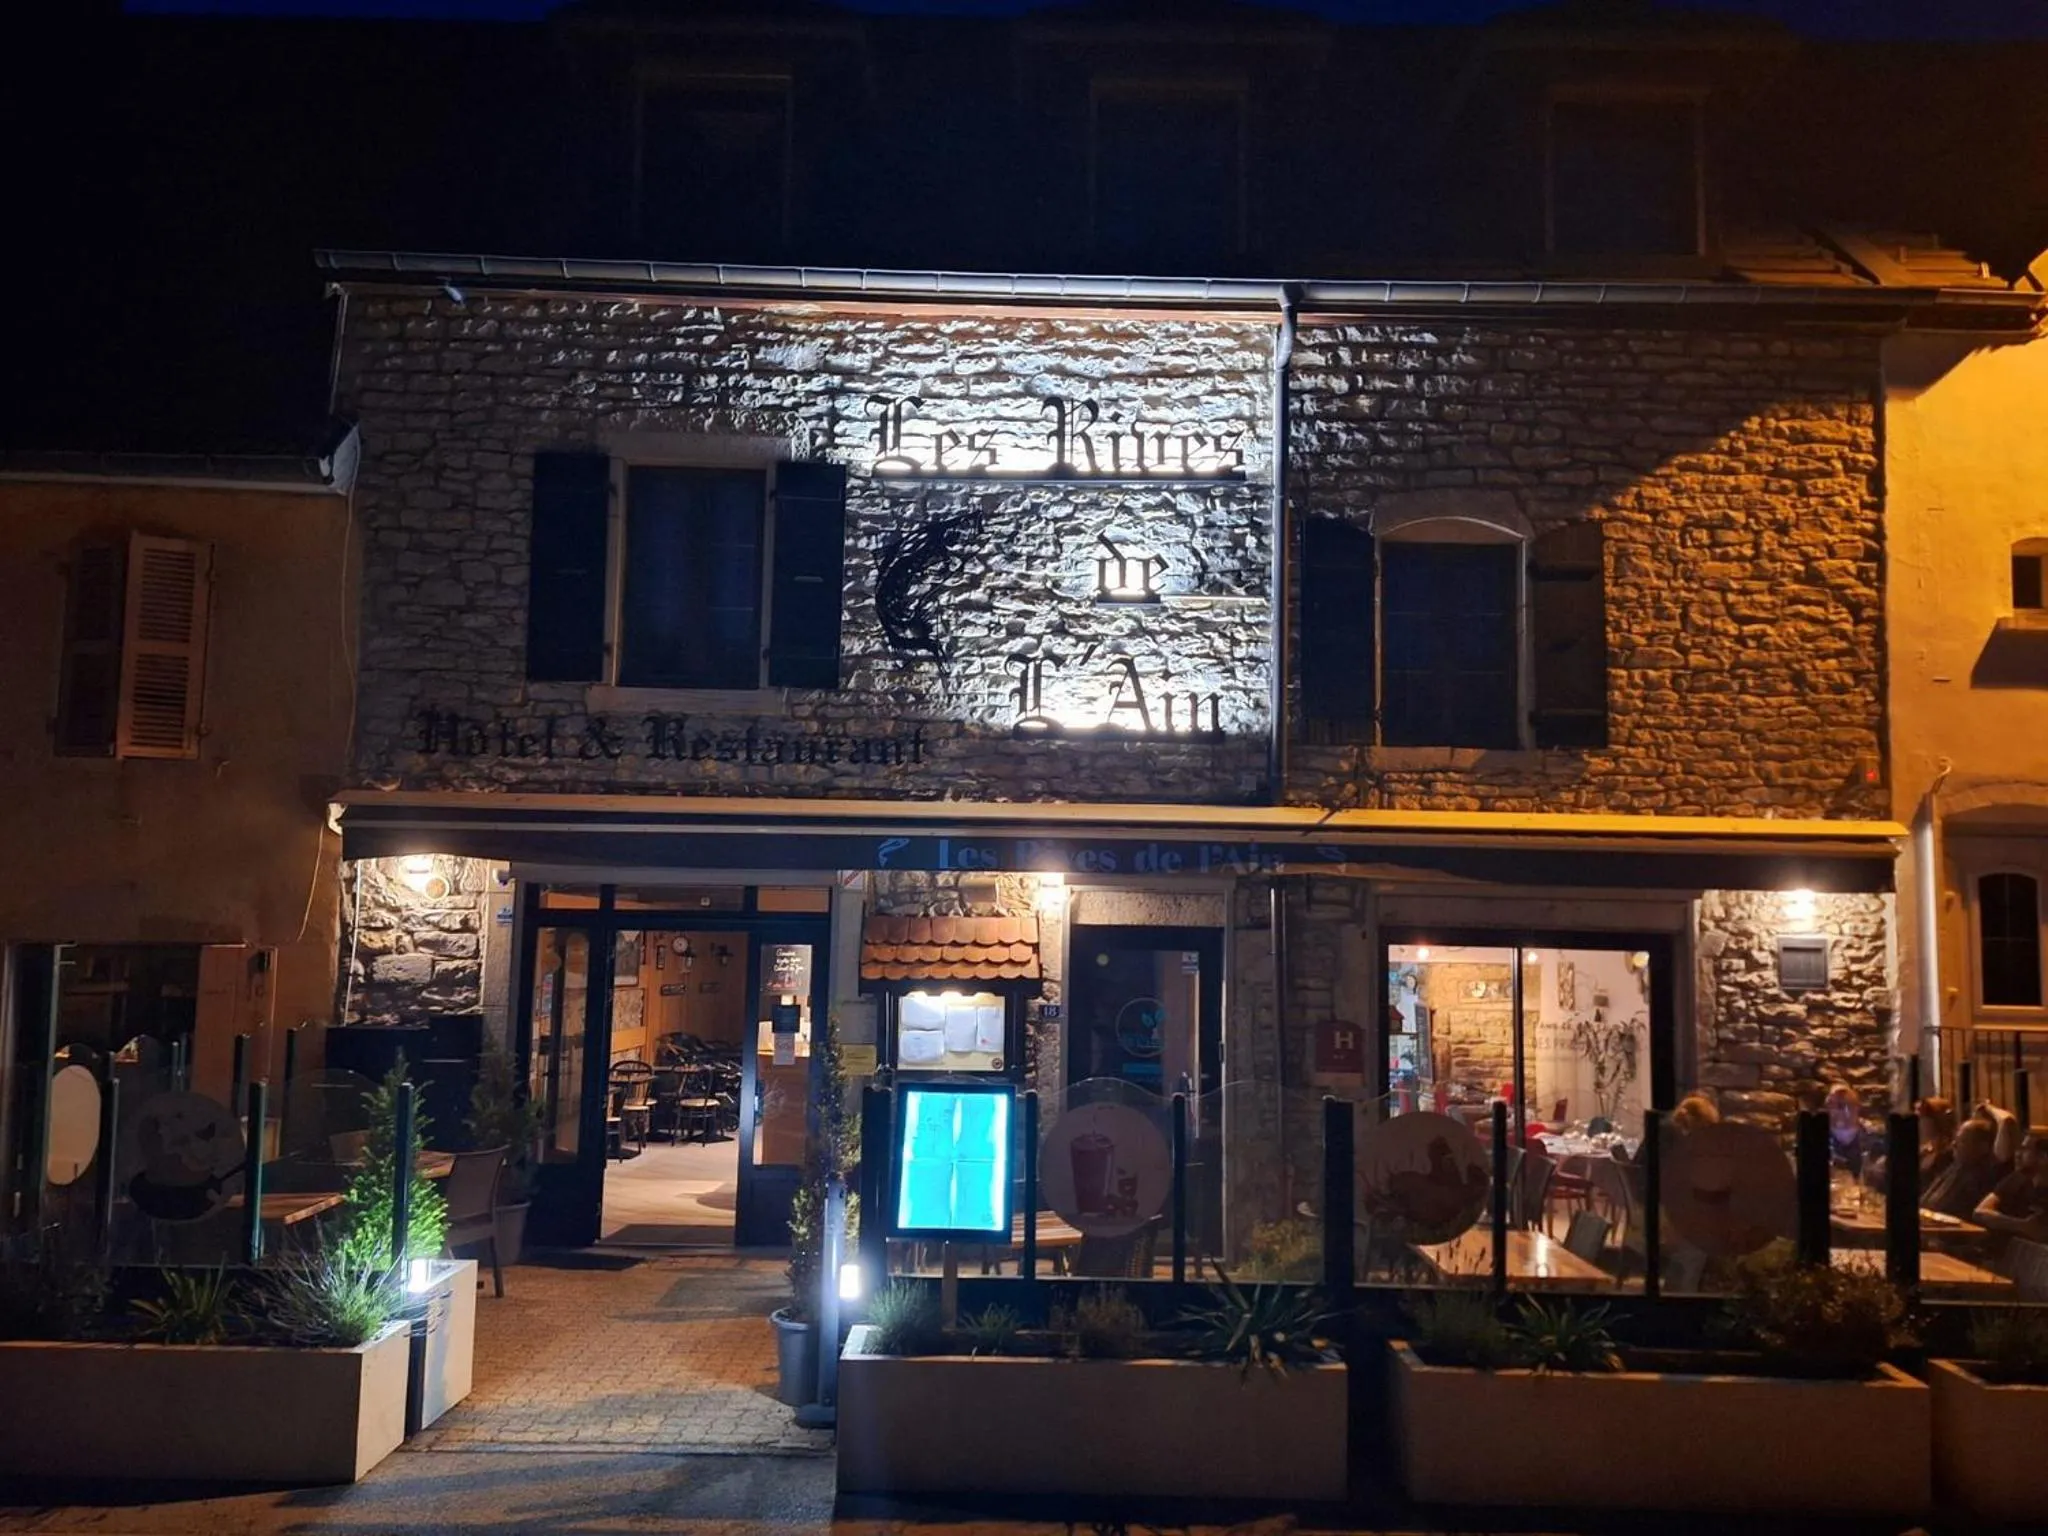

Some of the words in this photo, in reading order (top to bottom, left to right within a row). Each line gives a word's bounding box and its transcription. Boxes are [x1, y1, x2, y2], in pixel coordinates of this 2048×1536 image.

[864, 395, 1000, 476] Les
[1040, 396, 1246, 477] Rives
[1098, 531, 1169, 599] de
[577, 709, 624, 761] &
[643, 711, 934, 766] Restaurant
[939, 838, 999, 870] Les
[1015, 839, 1117, 873] Rves
[1134, 842, 1183, 874] de
[1334, 1030, 1354, 1050] H
